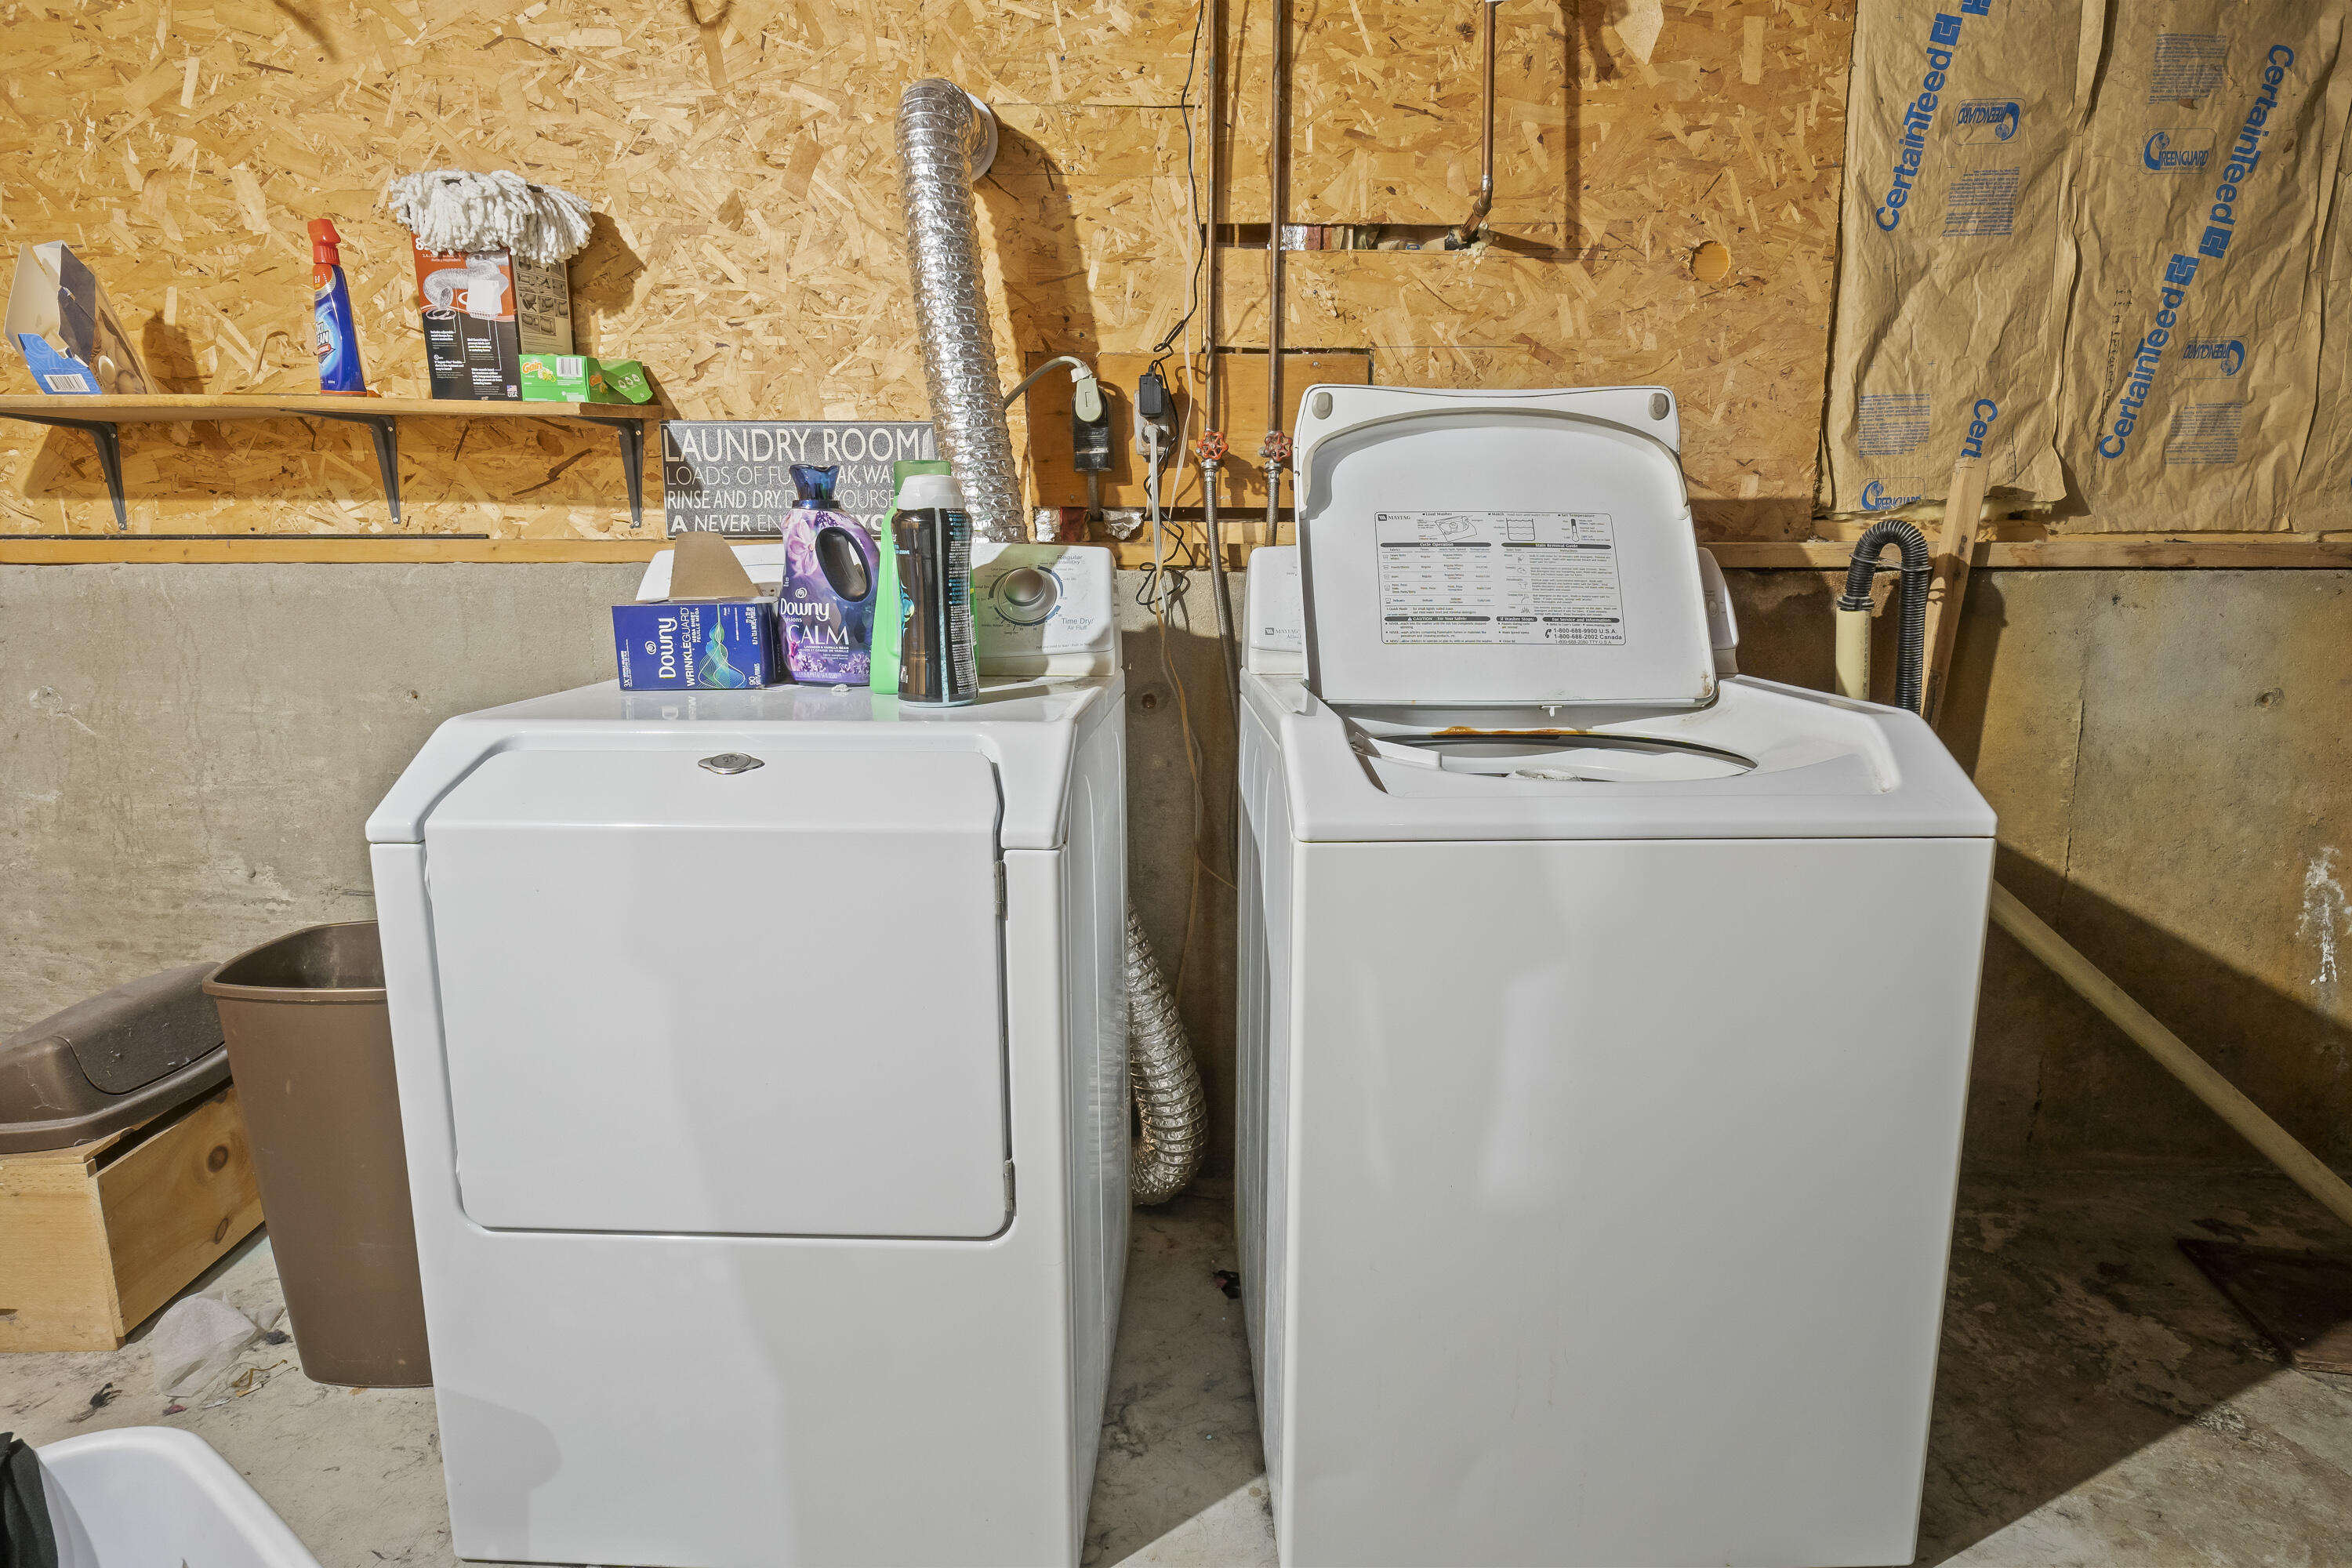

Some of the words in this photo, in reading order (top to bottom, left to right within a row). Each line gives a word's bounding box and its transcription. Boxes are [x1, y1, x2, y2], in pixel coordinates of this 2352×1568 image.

[1958, 102, 2020, 141] GREENGUARD
[2209, 44, 2294, 225] CertainTeed
[1875, 47, 1953, 232] CertainTeed
[2143, 132, 2209, 170] GREENGUARD
[522, 361, 543, 374] Gain
[2099, 286, 2185, 459] CertainTeed
[2183, 339, 2245, 376] GREENGUARD
[664, 428, 811, 462] LAUNDRY
[823, 427, 920, 462] ROOM
[666, 466, 731, 485] LOADS
[737, 465, 763, 485] OF
[667, 489, 711, 510] RINSE
[713, 490, 747, 510] AND
[670, 515, 688, 532] A
[694, 514, 751, 532] NEVER
[780, 597, 830, 622] Downy
[1080, 617, 1094, 626] Dry/
[659, 616, 677, 678] Downy
[788, 625, 849, 645] CALM
[749, 676, 756, 685] 90
